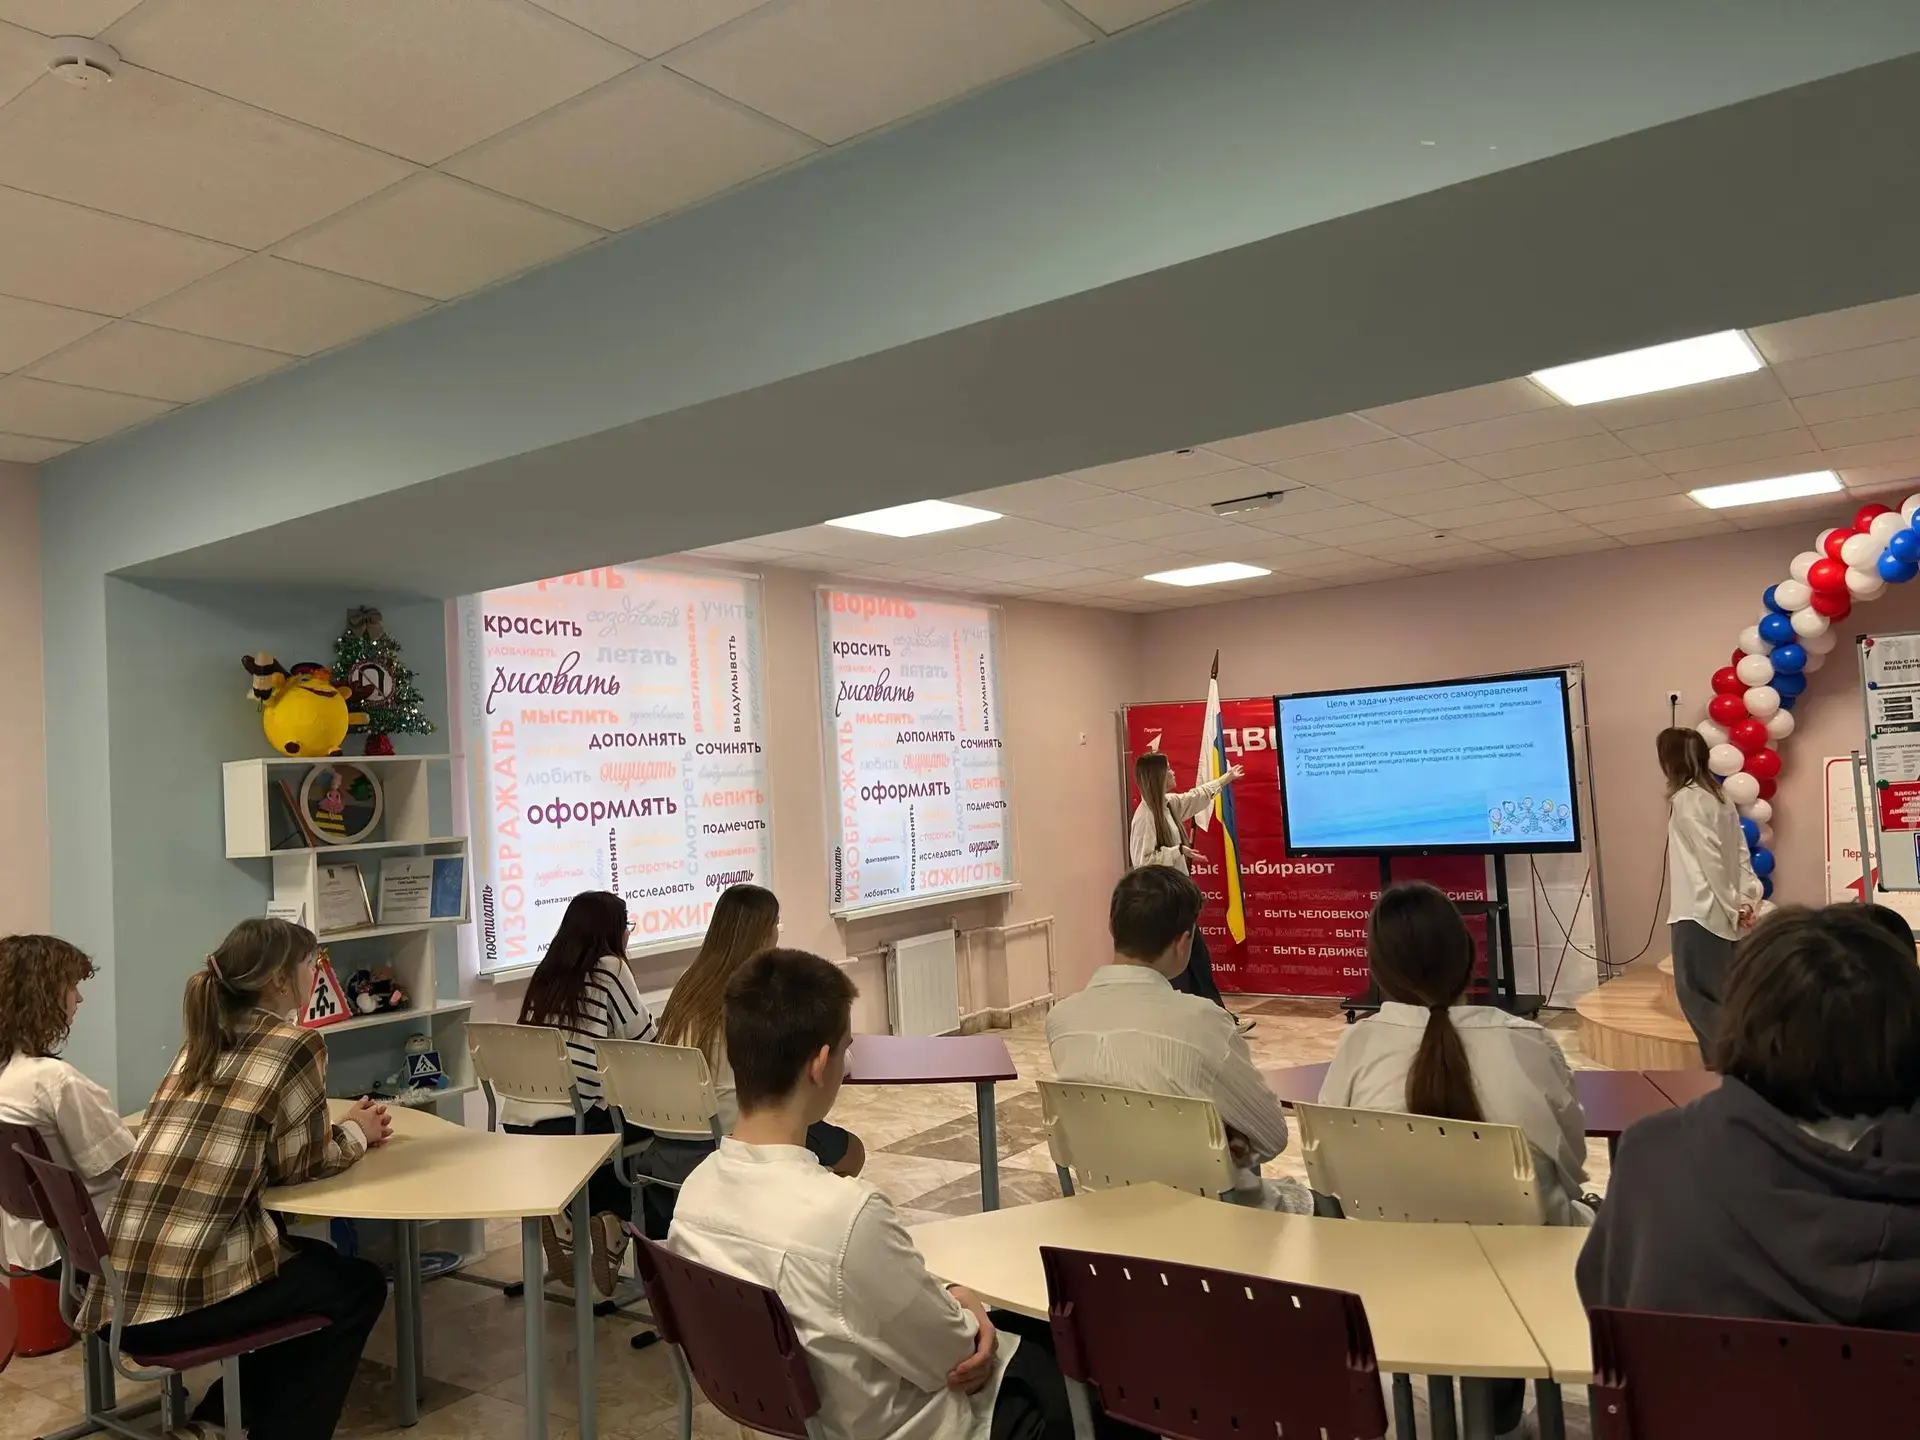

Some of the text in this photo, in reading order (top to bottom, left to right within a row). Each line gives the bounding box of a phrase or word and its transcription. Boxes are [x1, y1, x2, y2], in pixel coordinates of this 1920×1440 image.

[700, 601, 753, 621] учить
[823, 591, 917, 622] творить
[484, 615, 582, 638] красить
[597, 646, 677, 666] летать
[833, 640, 891, 658] красить
[486, 651, 620, 714] рисовать
[728, 635, 742, 732] выдумывать
[980, 653, 990, 731] выдумывать
[835, 667, 915, 718] рисовать
[1327, 700, 1348, 709] Цель
[1358, 698, 1387, 707] задачи
[1388, 692, 1449, 704] ученического
[1450, 686, 1528, 699] самоуправления
[520, 709, 620, 724] мыслить
[855, 713, 914, 725] мыслить
[896, 731, 955, 744] дополнять
[1877, 725, 1909, 734] Первые
[588, 732, 687, 750] дополнять
[695, 742, 762, 756] сочинять
[960, 738, 1003, 749] сочинять
[525, 767, 592, 786] любить
[702, 788, 765, 808] лепить
[860, 780, 951, 804] оформлять
[527, 796, 677, 829] оформлять
[681, 750, 698, 876] смотреть
[966, 800, 1007, 812] подмечать
[702, 820, 766, 834] подмечать
[491, 719, 528, 958] ИЗОБРАЖАТЬ
[608, 827, 620, 895] аменять
[919, 848, 963, 861] исследовать
[919, 861, 1001, 889] зажигать
[1240, 859, 1335, 877] ыбирают
[705, 869, 754, 892] созерцать
[625, 882, 695, 900] исследовать
[864, 887, 901, 899] любоваться
[1446, 889, 1484, 901] СИЕЙ
[482, 884, 498, 960] постигать
[1264, 909, 1297, 918] БЫТЬ
[1273, 945, 1306, 955] БЫТЬ
[1308, 946, 1316, 955] В
[1343, 967, 1369, 976] БЫТ
